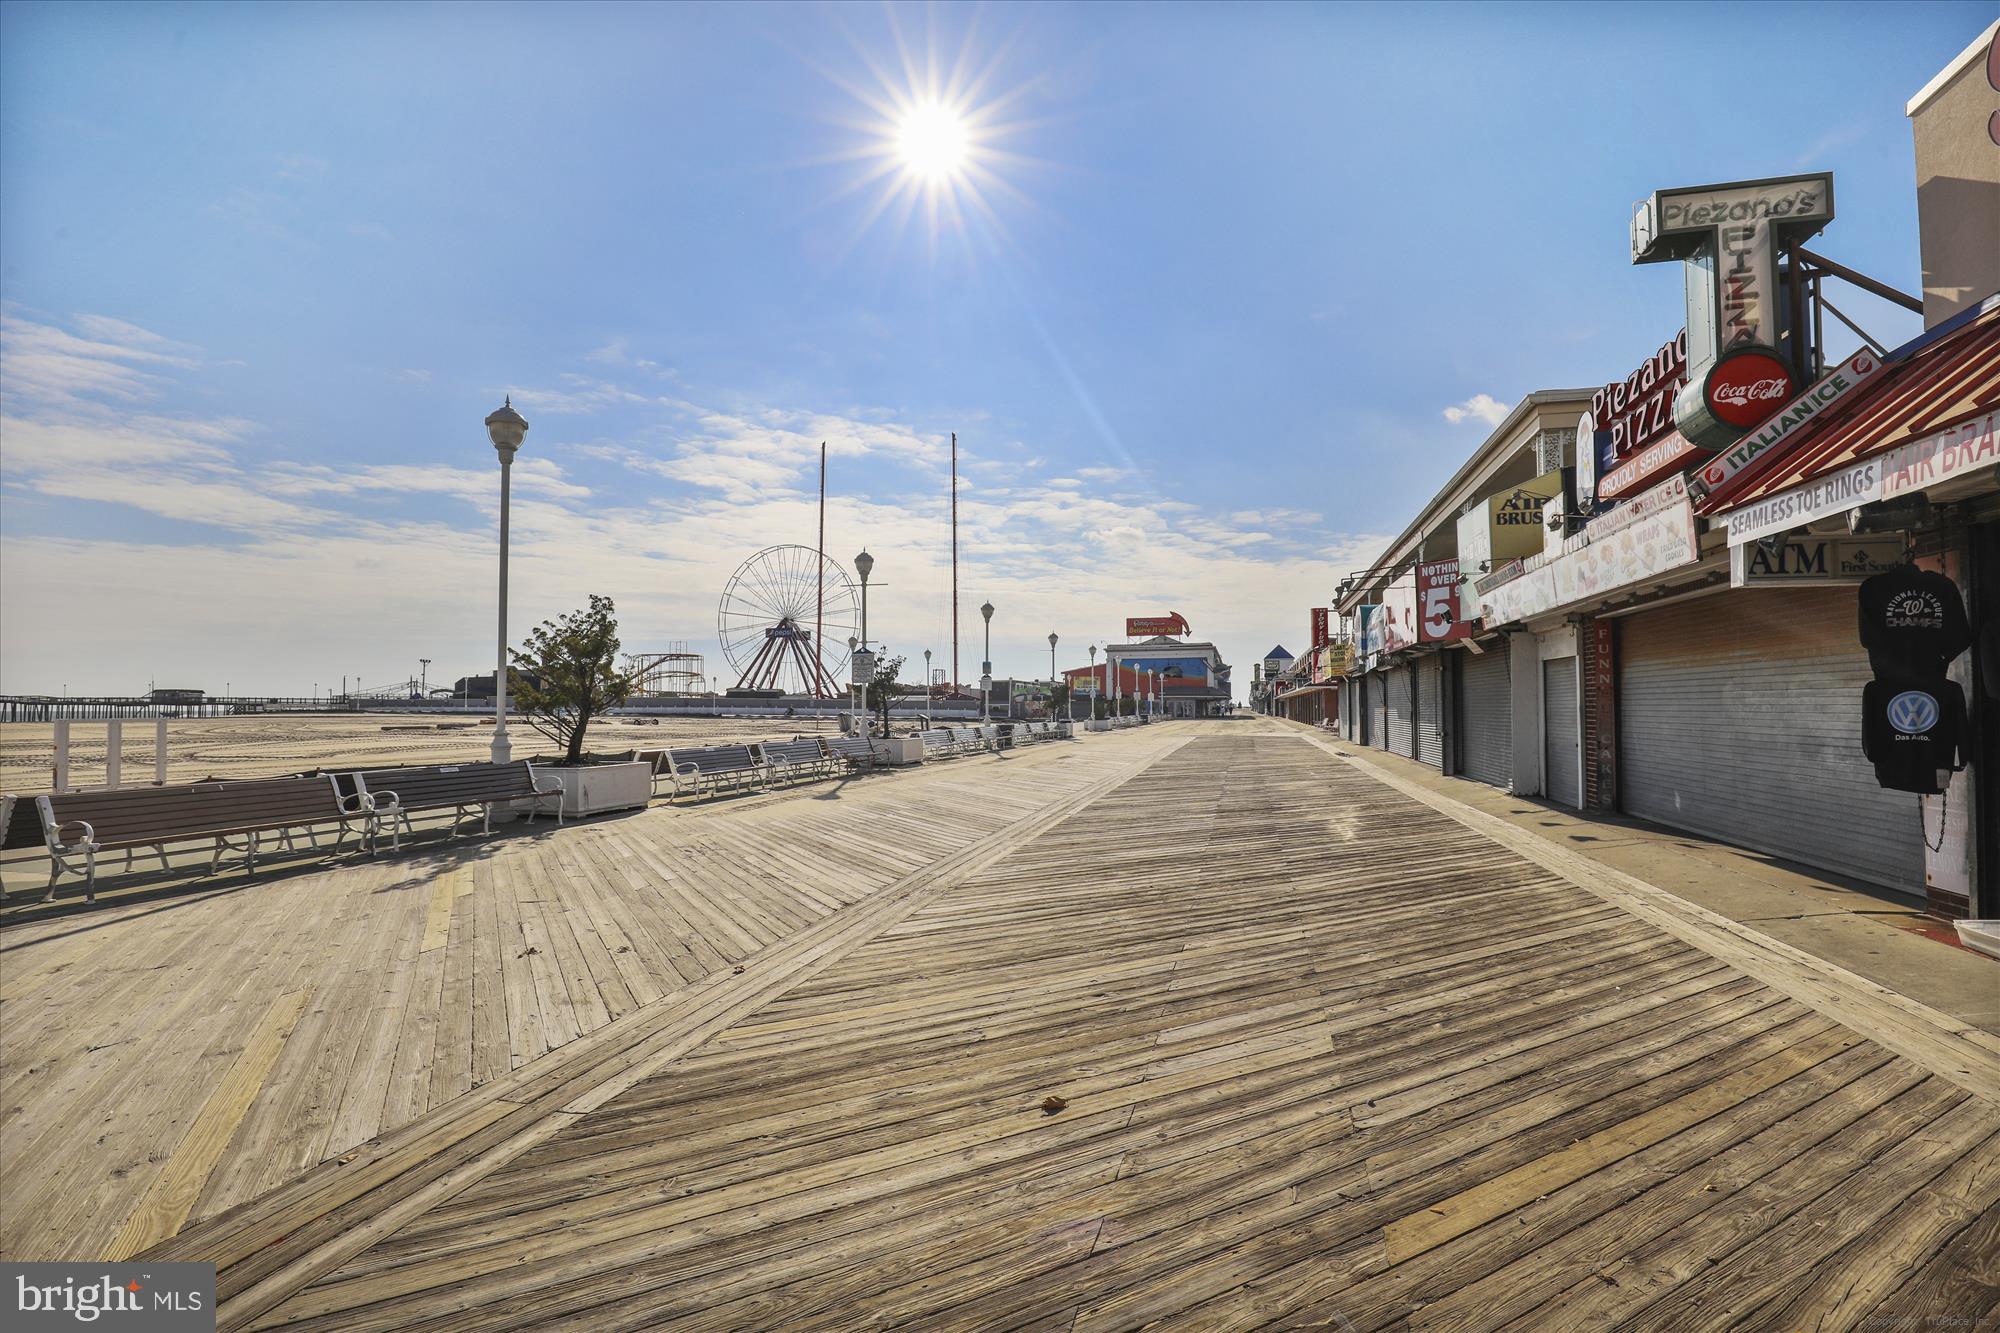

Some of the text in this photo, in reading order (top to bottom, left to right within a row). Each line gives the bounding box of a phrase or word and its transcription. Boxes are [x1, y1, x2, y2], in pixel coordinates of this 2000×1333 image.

[1663, 189, 1818, 227] Piezano's
[1726, 375, 1850, 470] ITALIAN ICE
[1601, 461, 1638, 496] PROUDLY
[1640, 438, 1683, 476] SERVING
[1882, 415, 2000, 495] HAIR BRA
[1732, 465, 1874, 536] SEAMLESS TOE RINGS
[1597, 510, 1627, 535] ITALIAN
[1748, 541, 1829, 575] ATM
[1430, 573, 1457, 586] OVER
[1886, 589, 1943, 617] NATIONAL LEAGUE
